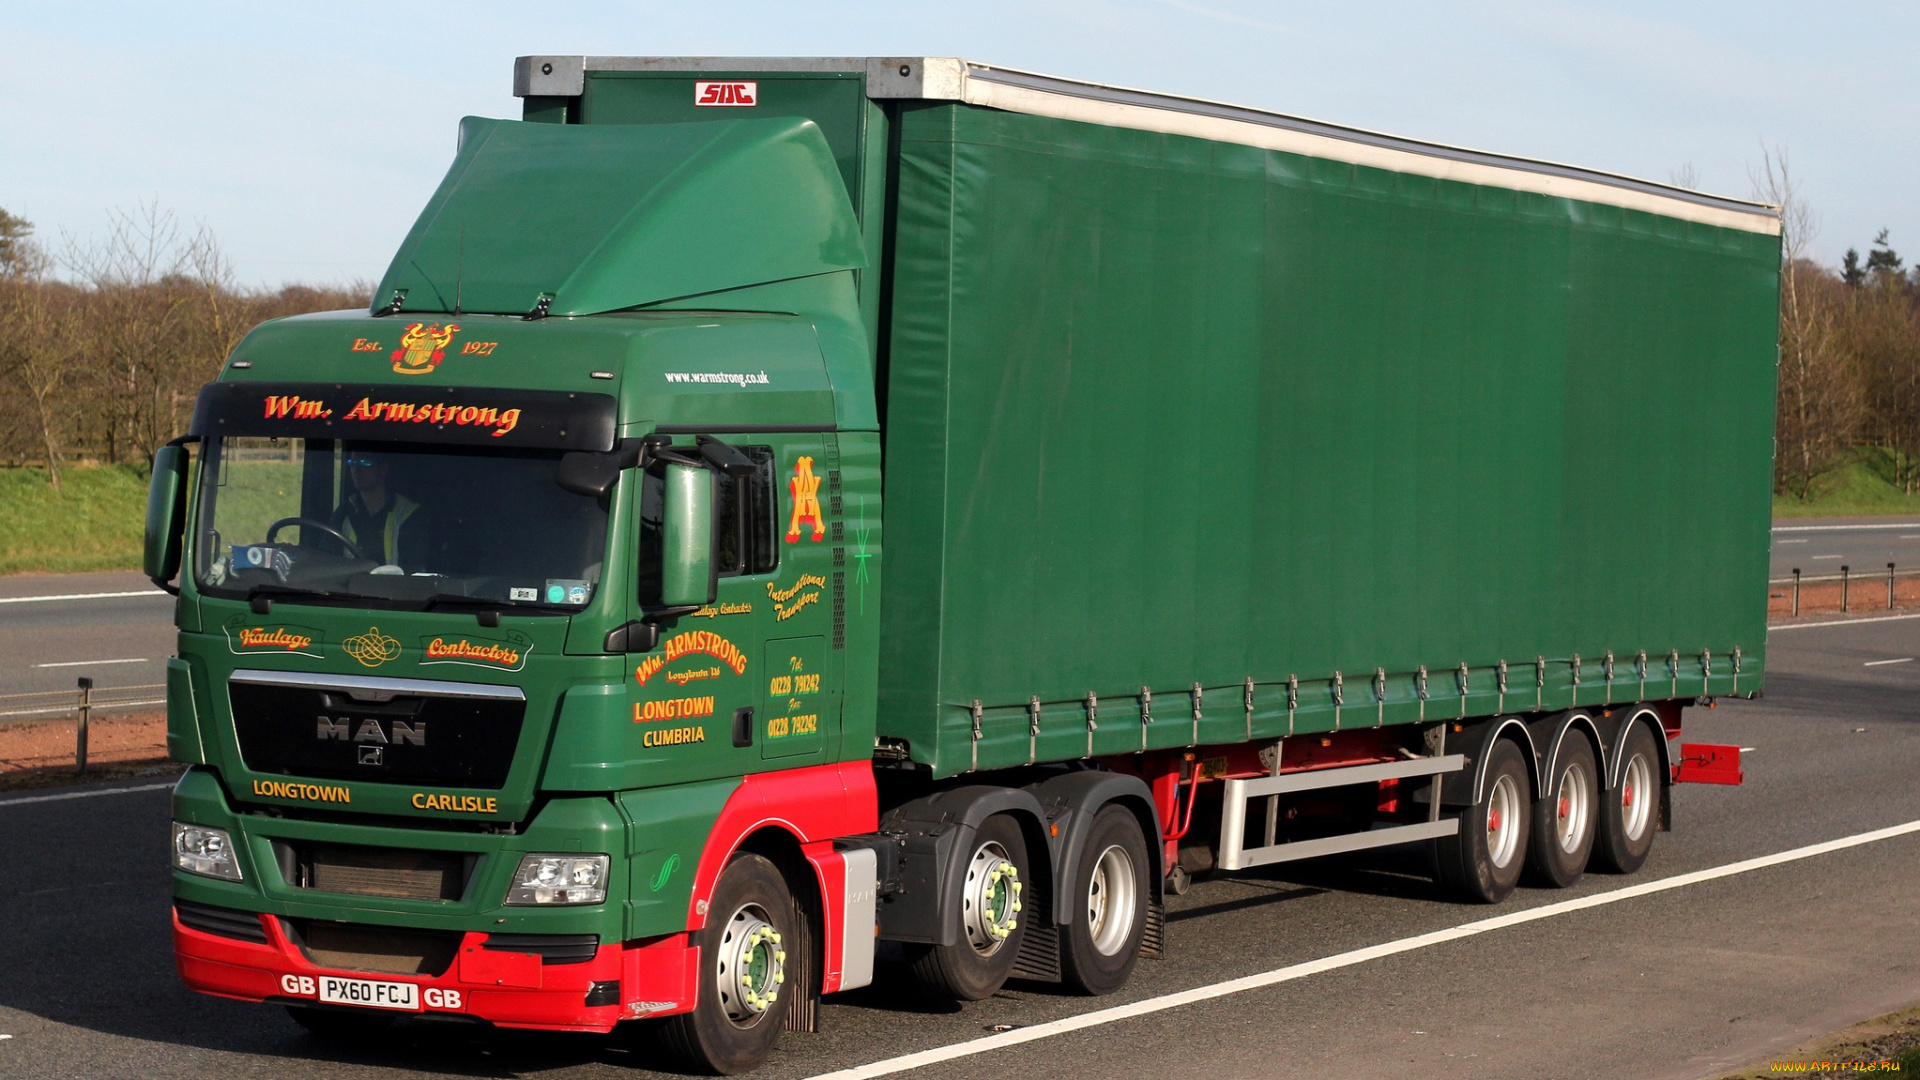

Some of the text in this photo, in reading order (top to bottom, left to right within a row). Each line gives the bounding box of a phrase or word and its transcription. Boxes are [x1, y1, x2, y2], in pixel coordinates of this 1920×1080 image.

[699, 84, 754, 104] SDC
[351, 338, 498, 356] Est. 1927
[664, 370, 770, 388] www.warmstrong.co.uk
[264, 395, 522, 438] Wm. Armstrong
[766, 573, 826, 602] International
[774, 592, 820, 622] Transport
[239, 627, 312, 651] Haulage
[426, 638, 519, 666] Contractors
[665, 630, 748, 676] ARMSTRONG
[666, 669, 709, 685] Longtown
[770, 673, 820, 697] 01228 791242
[633, 696, 714, 723] LONGTOWN
[317, 715, 426, 746] MAN
[643, 726, 705, 748] CUMBRIA
[767, 714, 817, 739] 01228 792242
[253, 779, 351, 804] LONGTOWN
[411, 793, 498, 814] CARLISLE
[281, 974, 316, 995] GB
[327, 980, 411, 1004] PX60 FCJ
[424, 988, 462, 1009] GB
